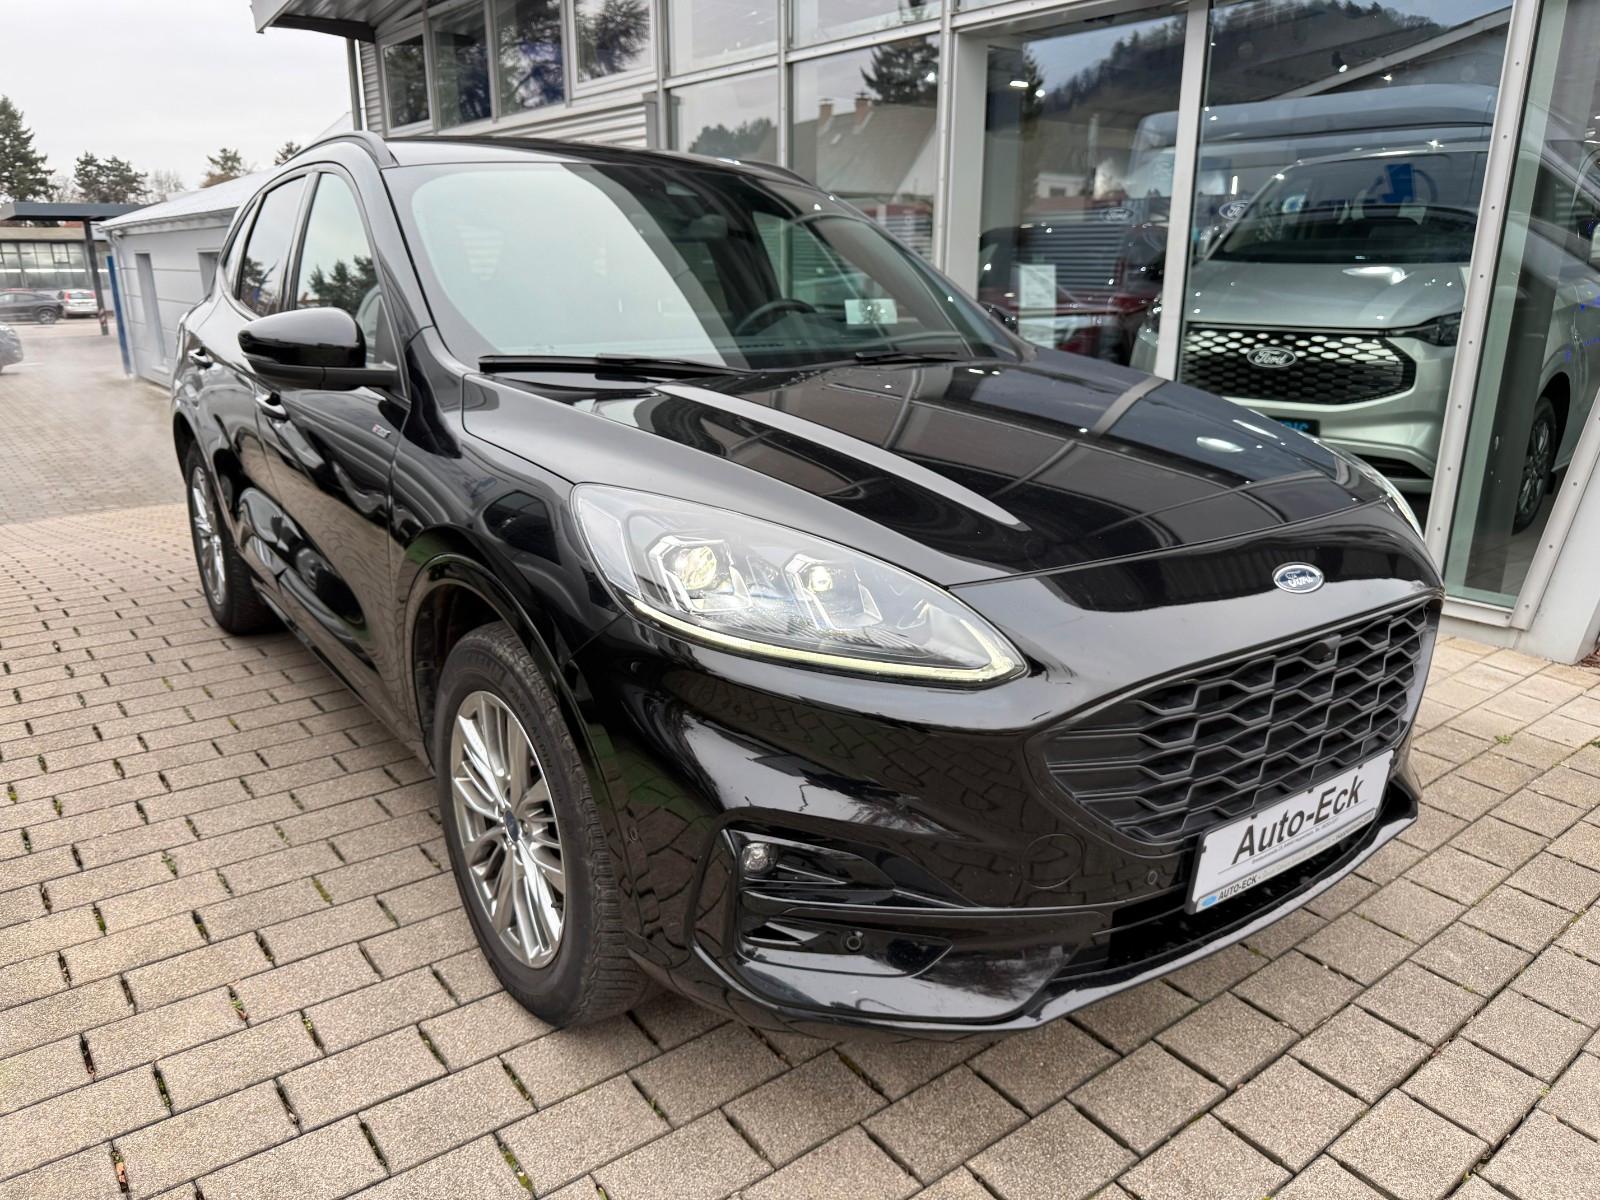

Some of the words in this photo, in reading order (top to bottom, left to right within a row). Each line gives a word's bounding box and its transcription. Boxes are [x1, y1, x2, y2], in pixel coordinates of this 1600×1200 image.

[1254, 350, 1288, 365] Ford
[1231, 775, 1364, 865] Auto-Eck
[1217, 876, 1257, 901] AUTO-ECK
